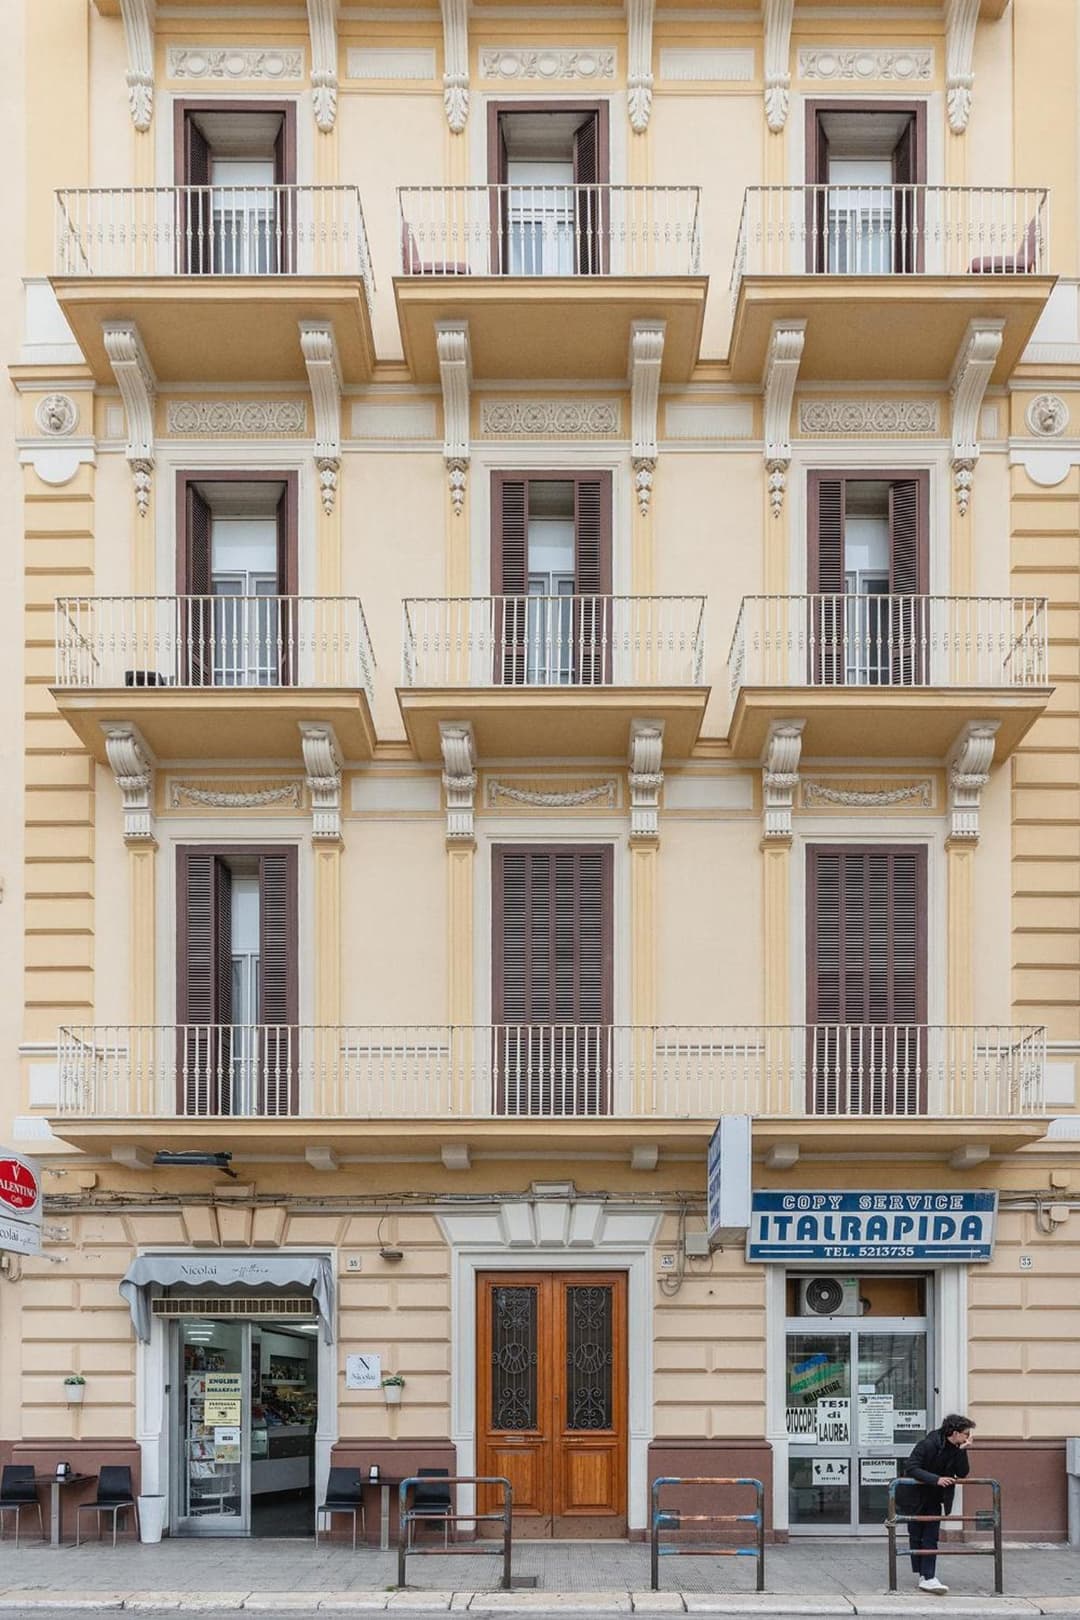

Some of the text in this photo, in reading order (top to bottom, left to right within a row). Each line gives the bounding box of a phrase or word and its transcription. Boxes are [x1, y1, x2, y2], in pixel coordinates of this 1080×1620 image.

[0, 1179, 36, 1199] ALENTINO
[783, 1195, 964, 1210] COPY SERVICE
[759, 1215, 983, 1241] ITALRAPIDA
[824, 1247, 915, 1257] TEL. 5213735
[181, 1264, 217, 1275] Nicolai
[819, 1400, 849, 1408] TESI
[785, 1408, 817, 1433] OTOCOPIE
[819, 1423, 849, 1442] LAUREA
